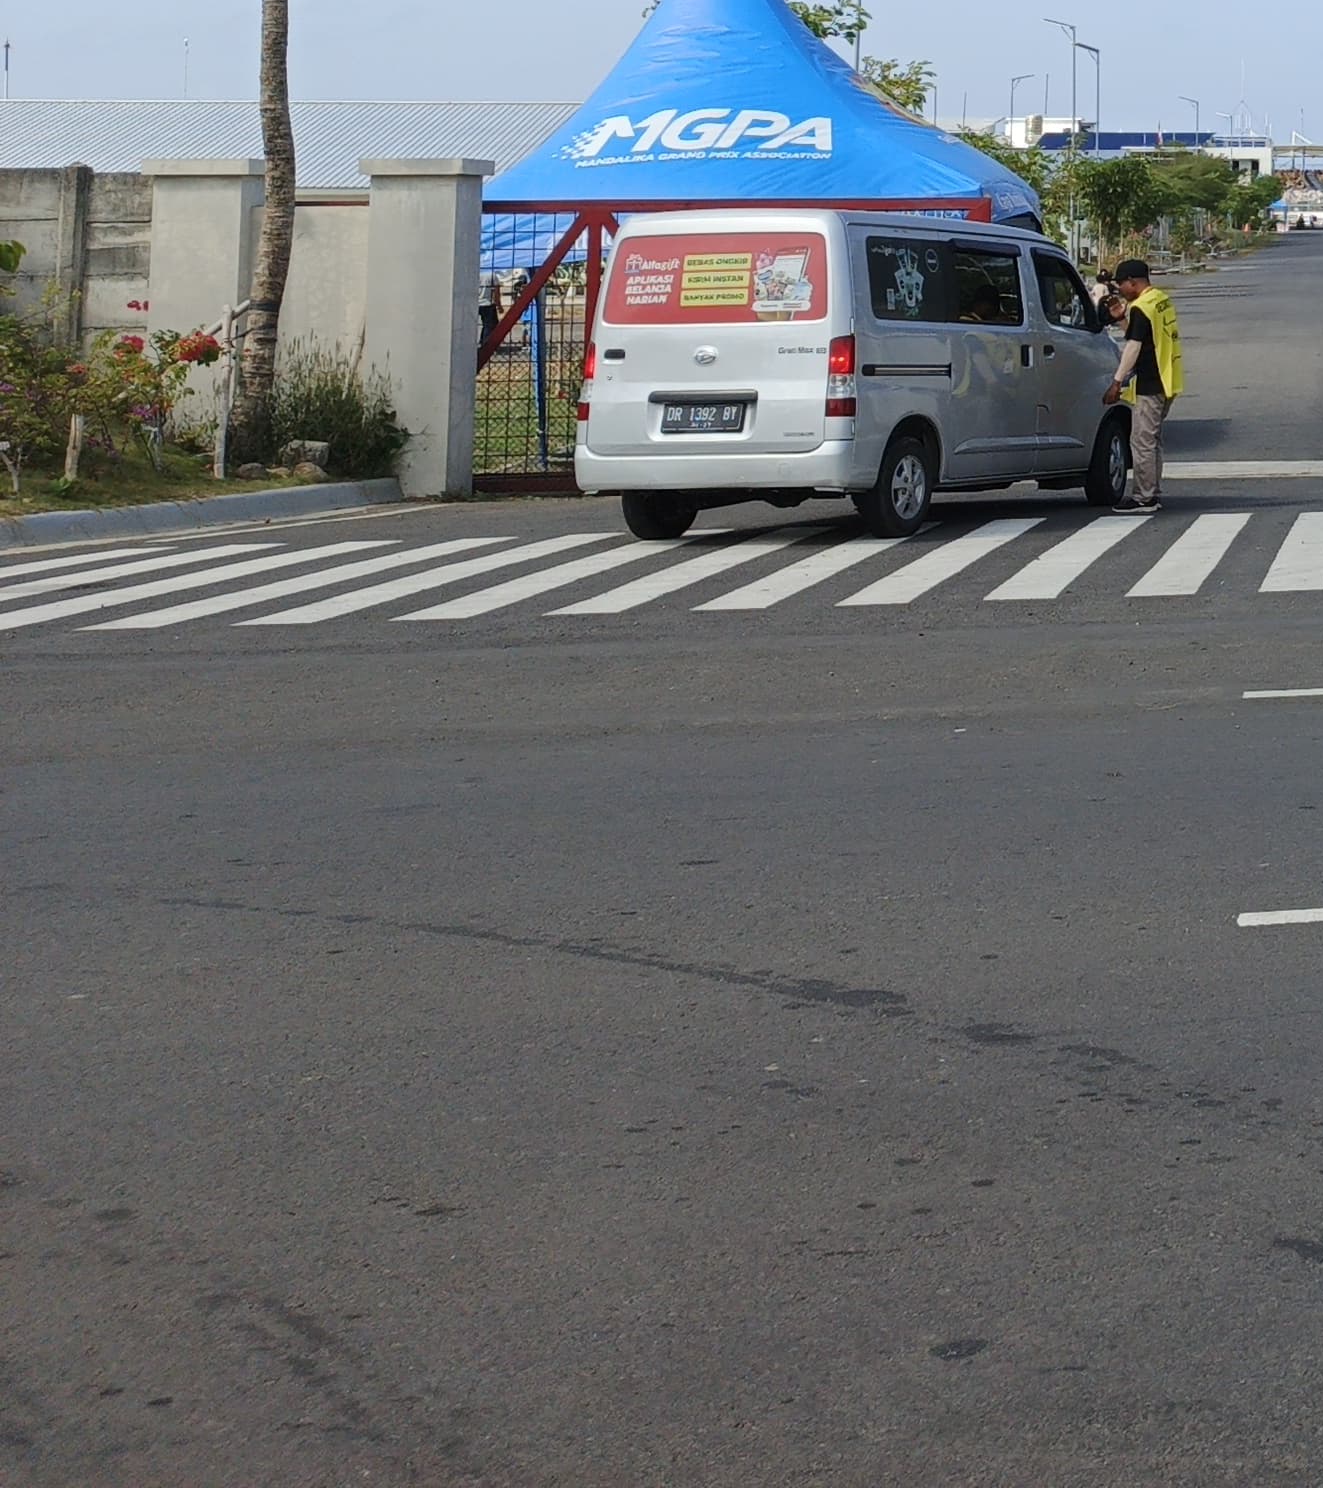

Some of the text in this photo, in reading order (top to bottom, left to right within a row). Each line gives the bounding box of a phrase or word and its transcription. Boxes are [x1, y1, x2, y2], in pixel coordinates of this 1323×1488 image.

[566, 108, 833, 159] MGPA
[575, 151, 832, 168] MANDALIKA GRAND PRIX ASSOCIATION
[626, 275, 674, 285] APLIKASI
[667, 407, 737, 421] DR 1392 BY
